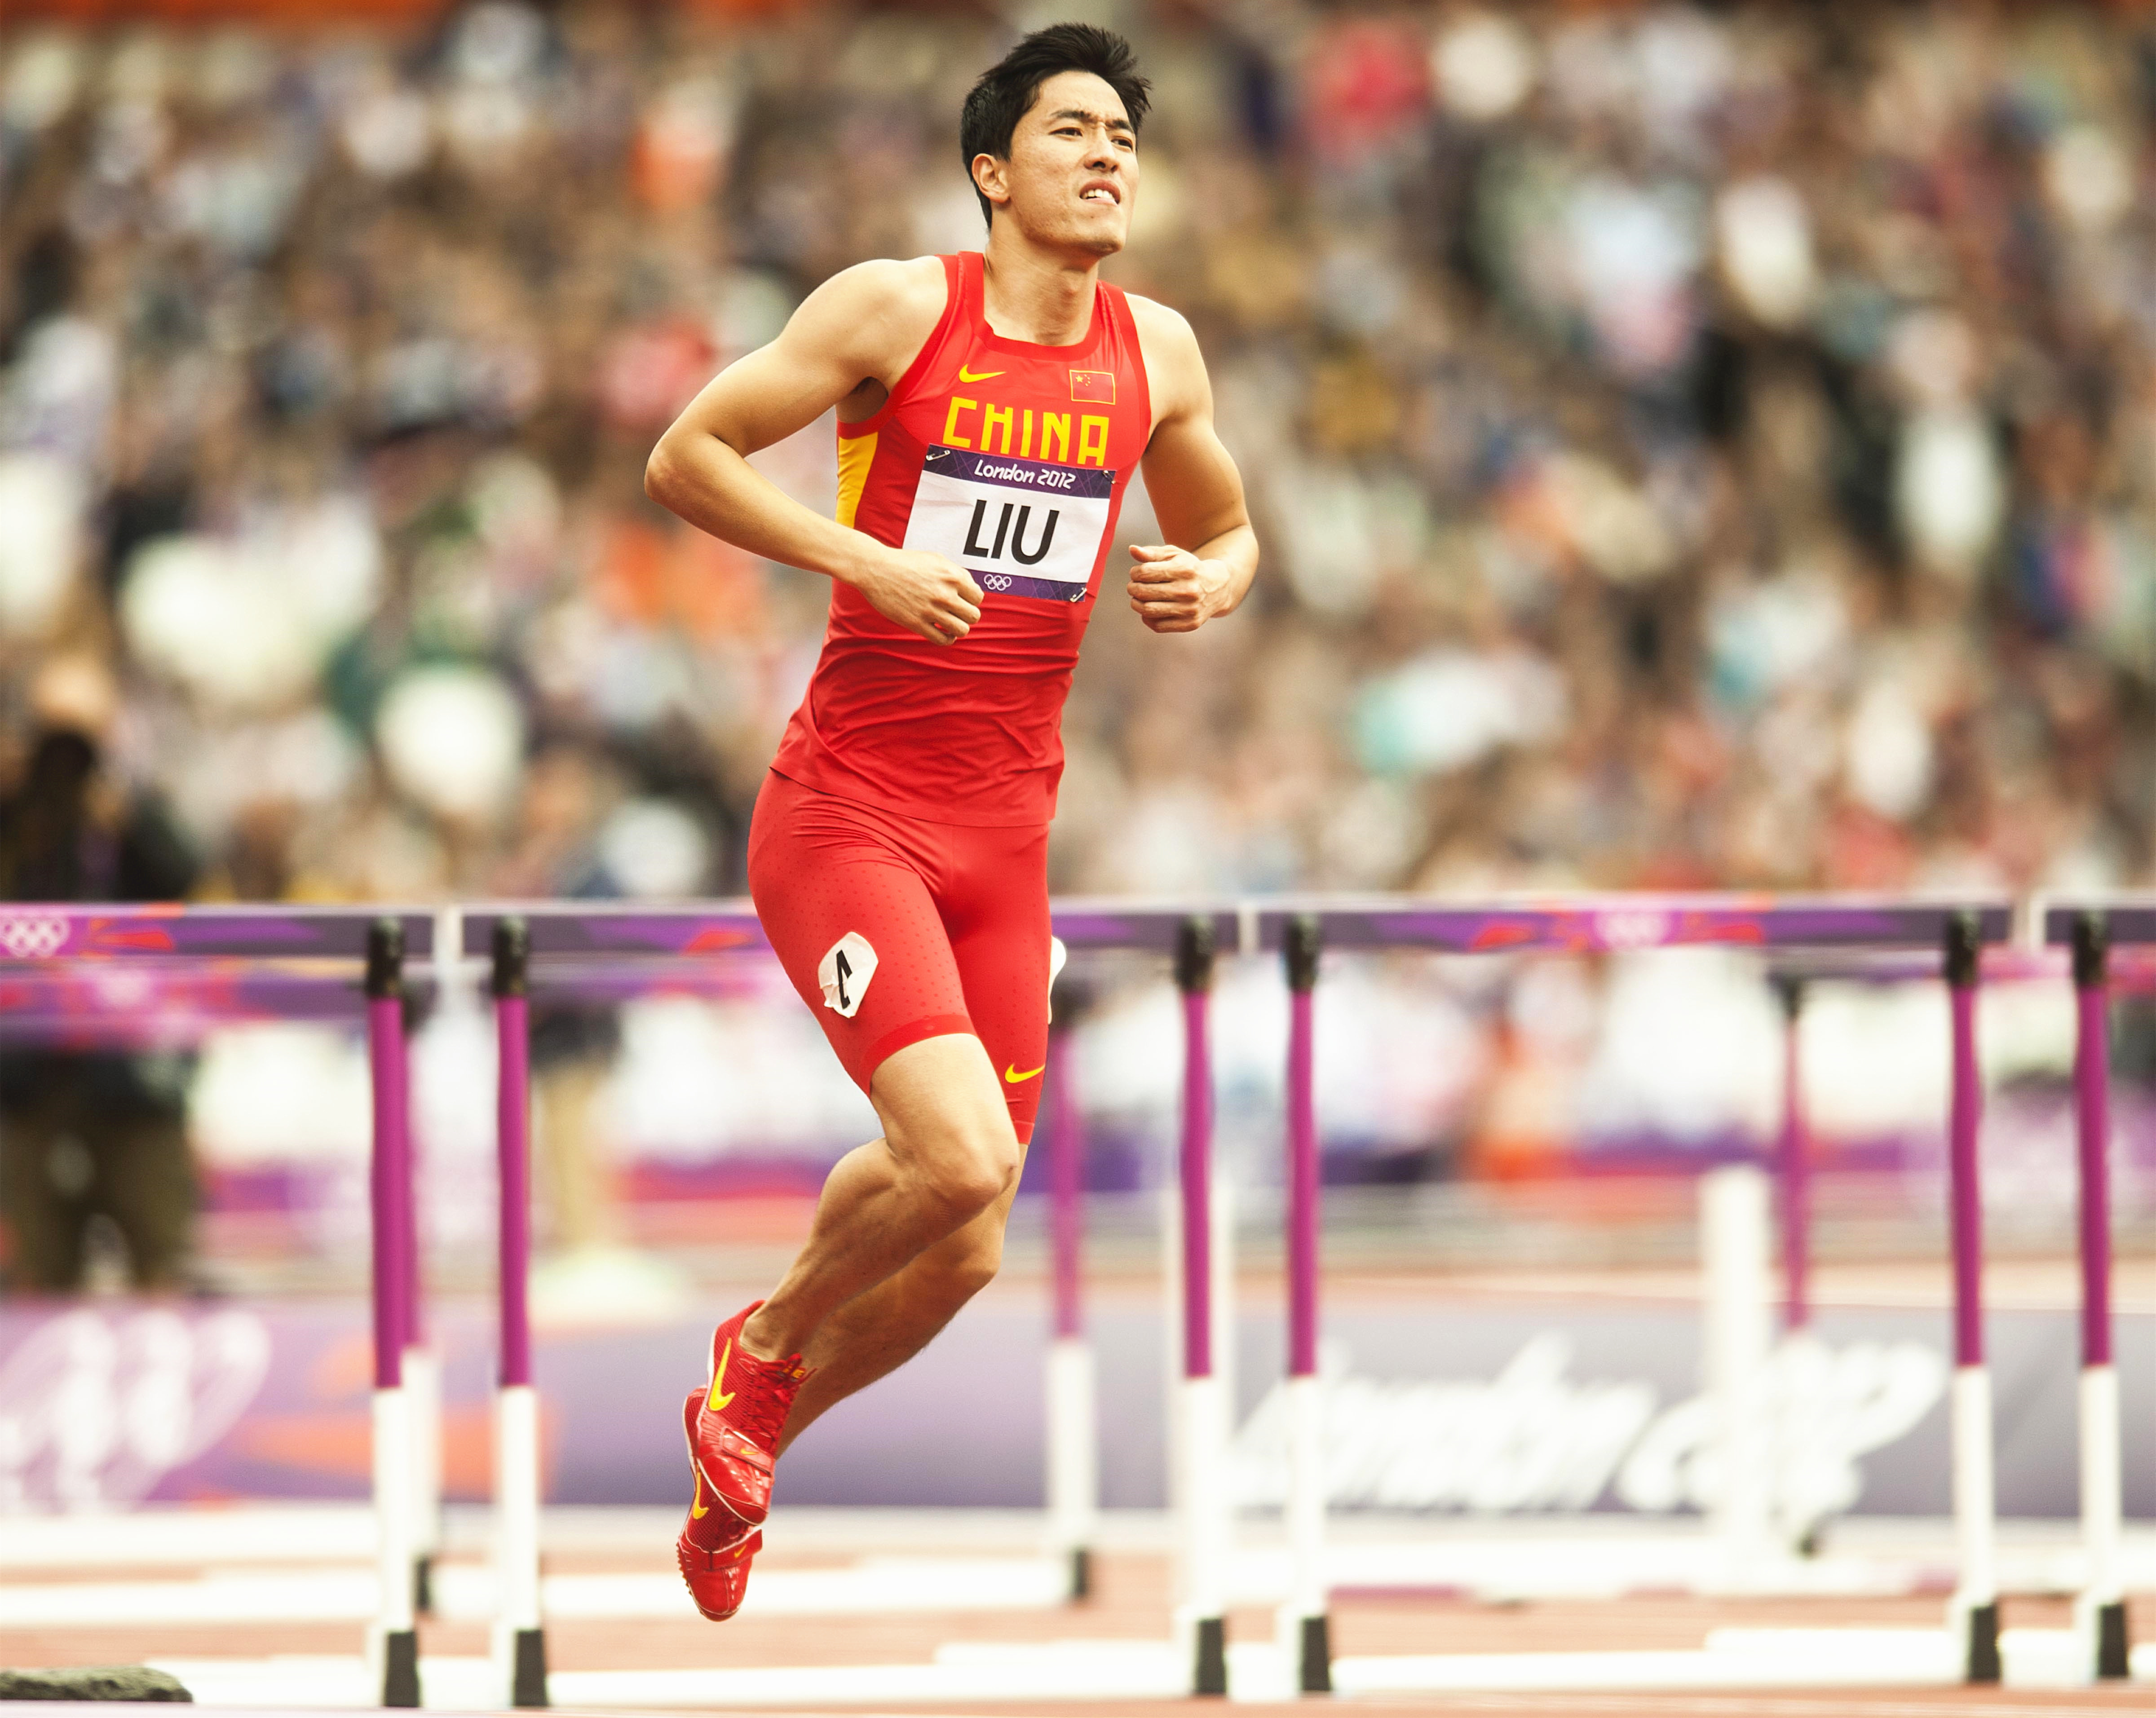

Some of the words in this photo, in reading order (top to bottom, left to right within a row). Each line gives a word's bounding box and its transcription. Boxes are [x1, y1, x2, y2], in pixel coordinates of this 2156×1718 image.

[943, 397, 1109, 466] CHINA
[974, 459, 1035, 484] London
[1037, 468, 1076, 489] 2012
[963, 499, 1060, 565] LIU
